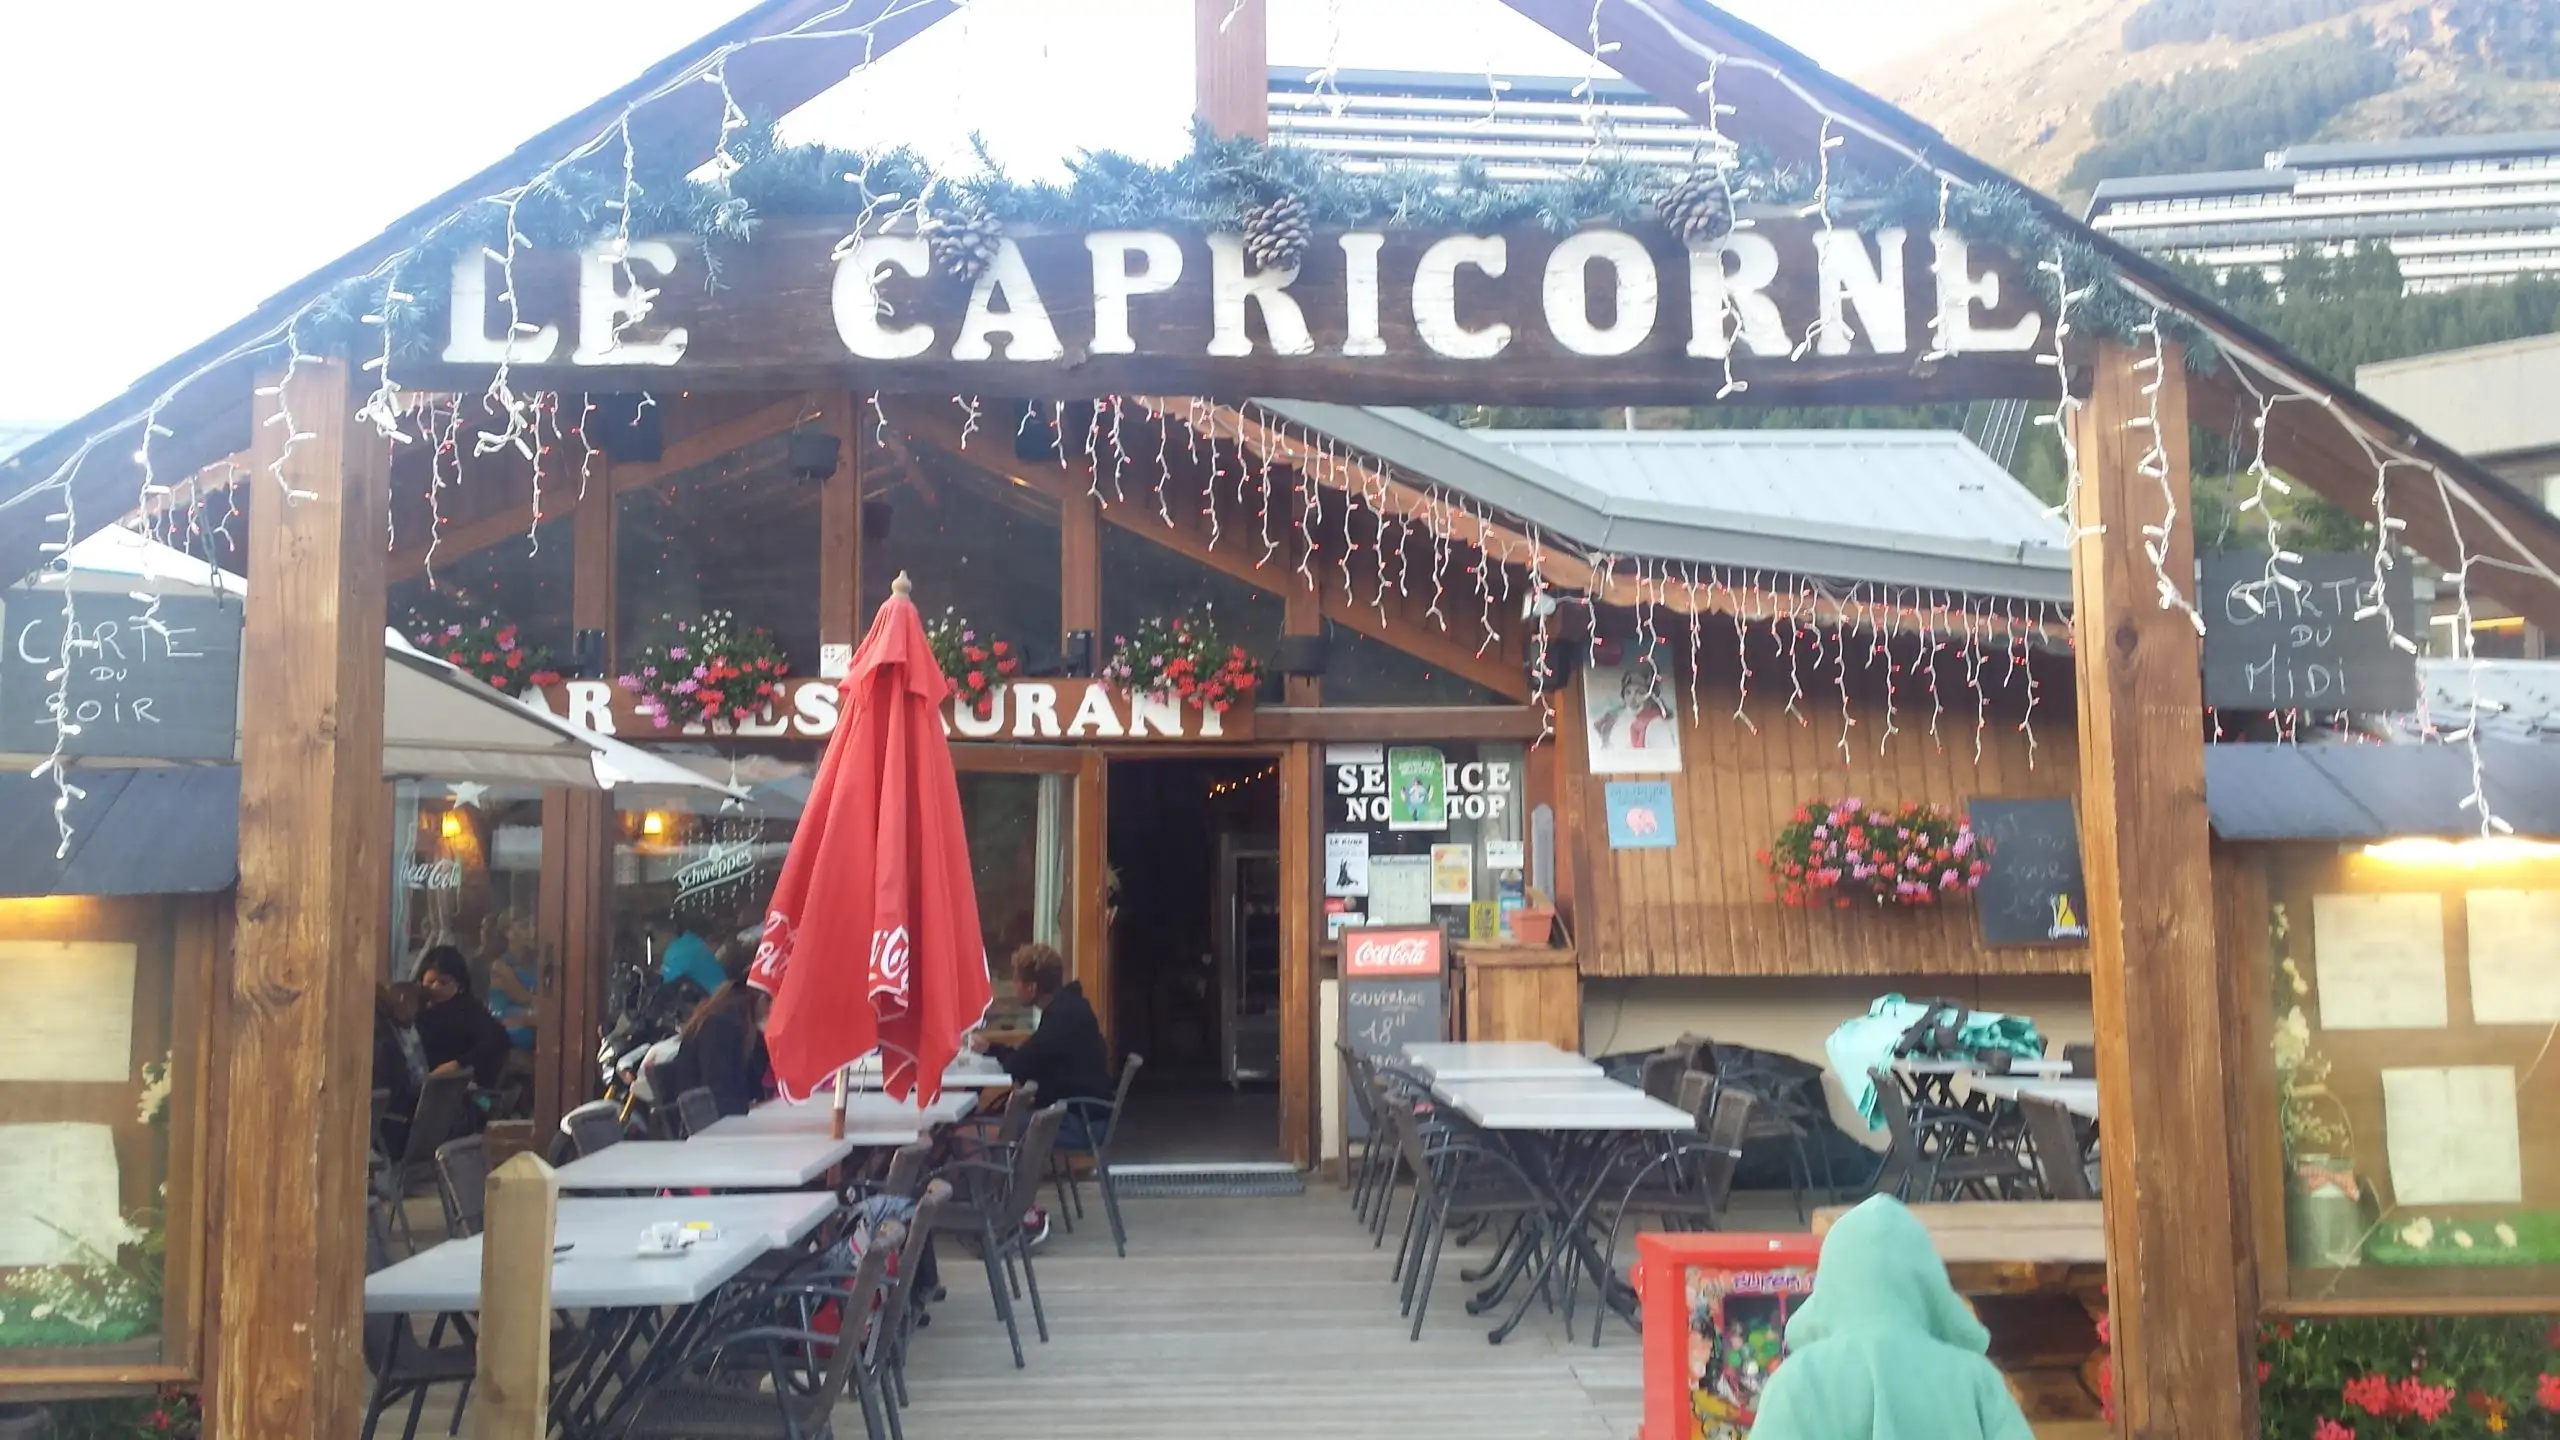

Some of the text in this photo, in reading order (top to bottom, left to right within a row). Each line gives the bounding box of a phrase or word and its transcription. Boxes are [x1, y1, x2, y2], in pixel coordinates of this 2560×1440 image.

[442, 228, 2042, 366] LE CAPRICORNE
[18, 618, 204, 664] CARTE
[2290, 623, 2332, 648] DU
[90, 666, 128, 681] DU
[1337, 761, 1512, 795] SEICE
[1446, 793, 1507, 820] TOP
[677, 848, 752, 892] Schweppes
